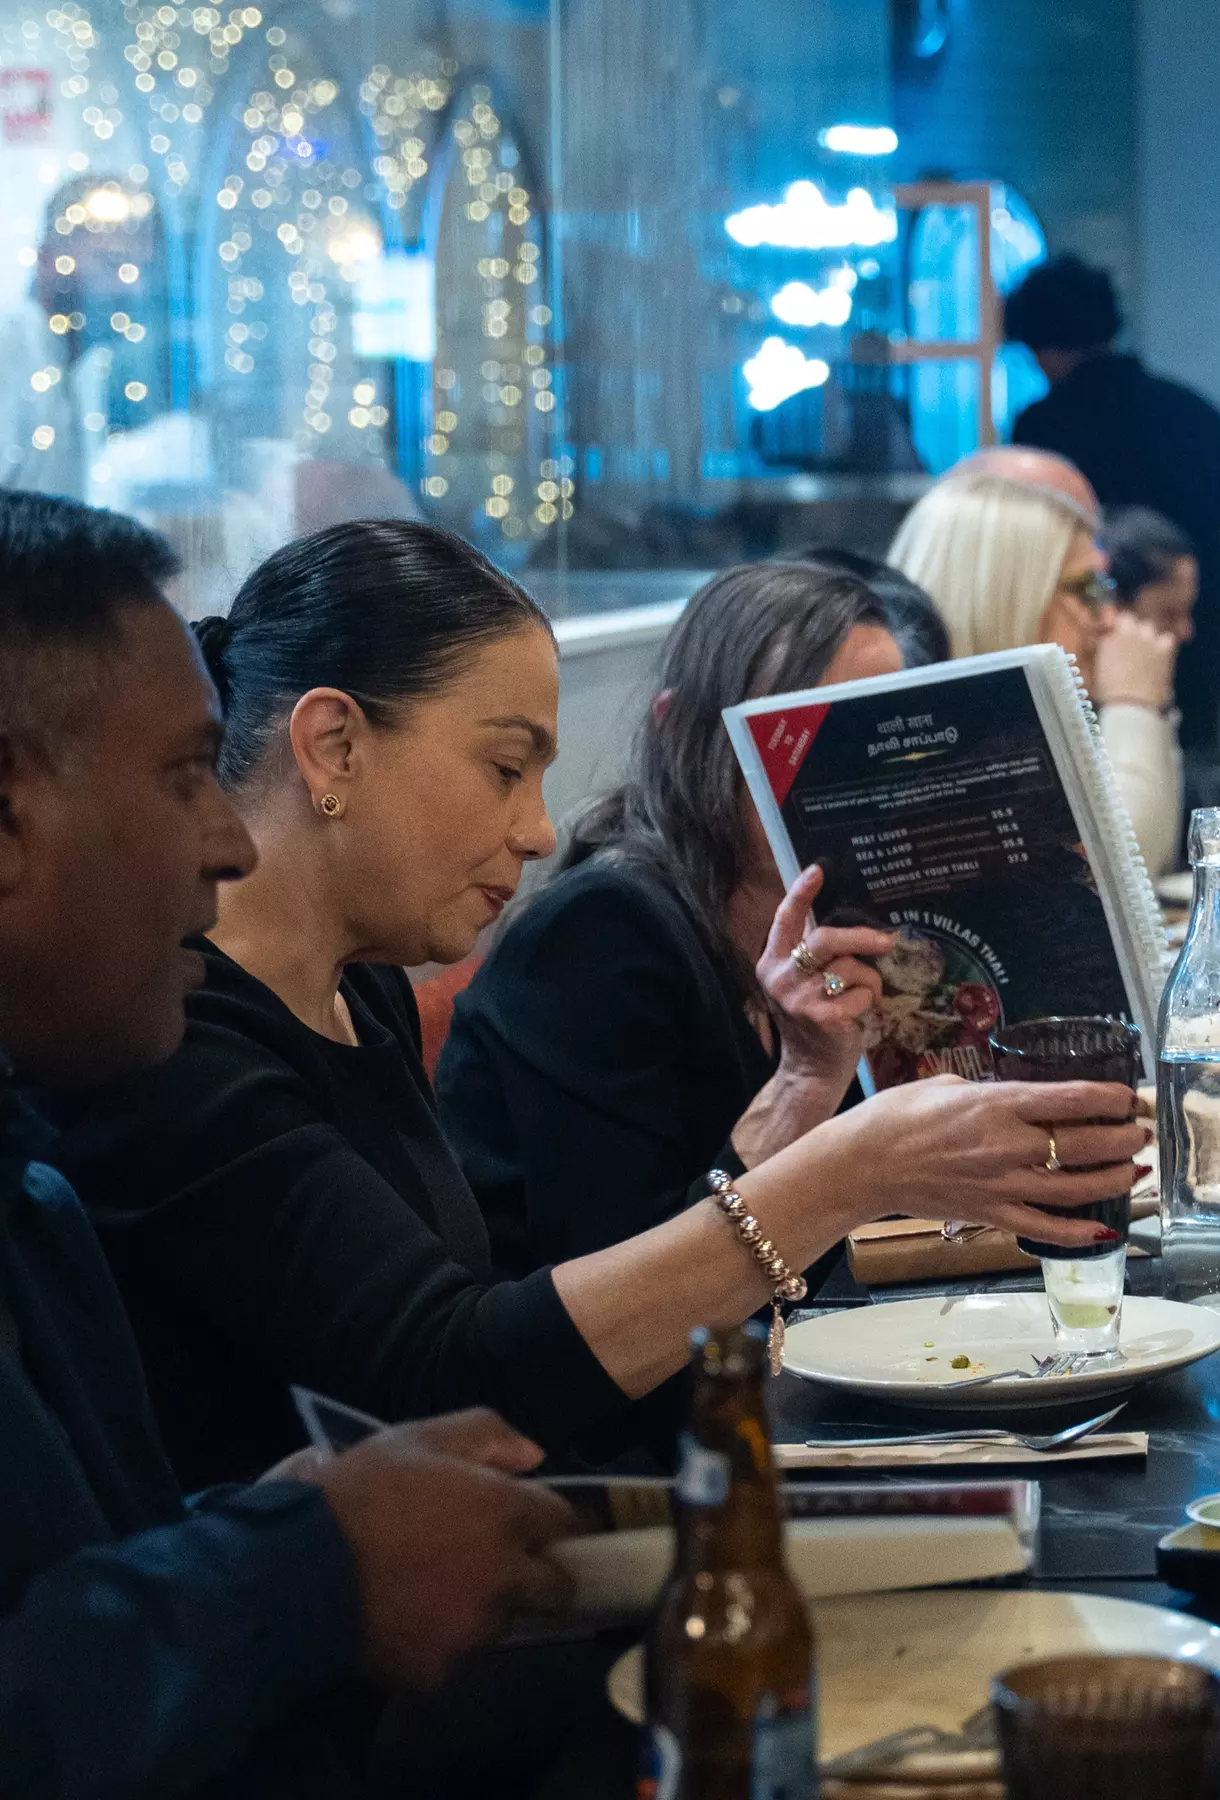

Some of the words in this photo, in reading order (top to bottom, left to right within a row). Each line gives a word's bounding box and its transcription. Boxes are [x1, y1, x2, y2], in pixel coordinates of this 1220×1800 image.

[851, 834, 876, 846] MEAT
[878, 828, 908, 843] LOVER
[882, 858, 912, 872] LOVER
[923, 866, 950, 880] YOUR
[951, 860, 980, 874] THALI
[903, 910, 919, 922] IN
[923, 912, 930, 924] 1
[932, 914, 982, 948] VILLAS
[980, 942, 1010, 984] THALI
